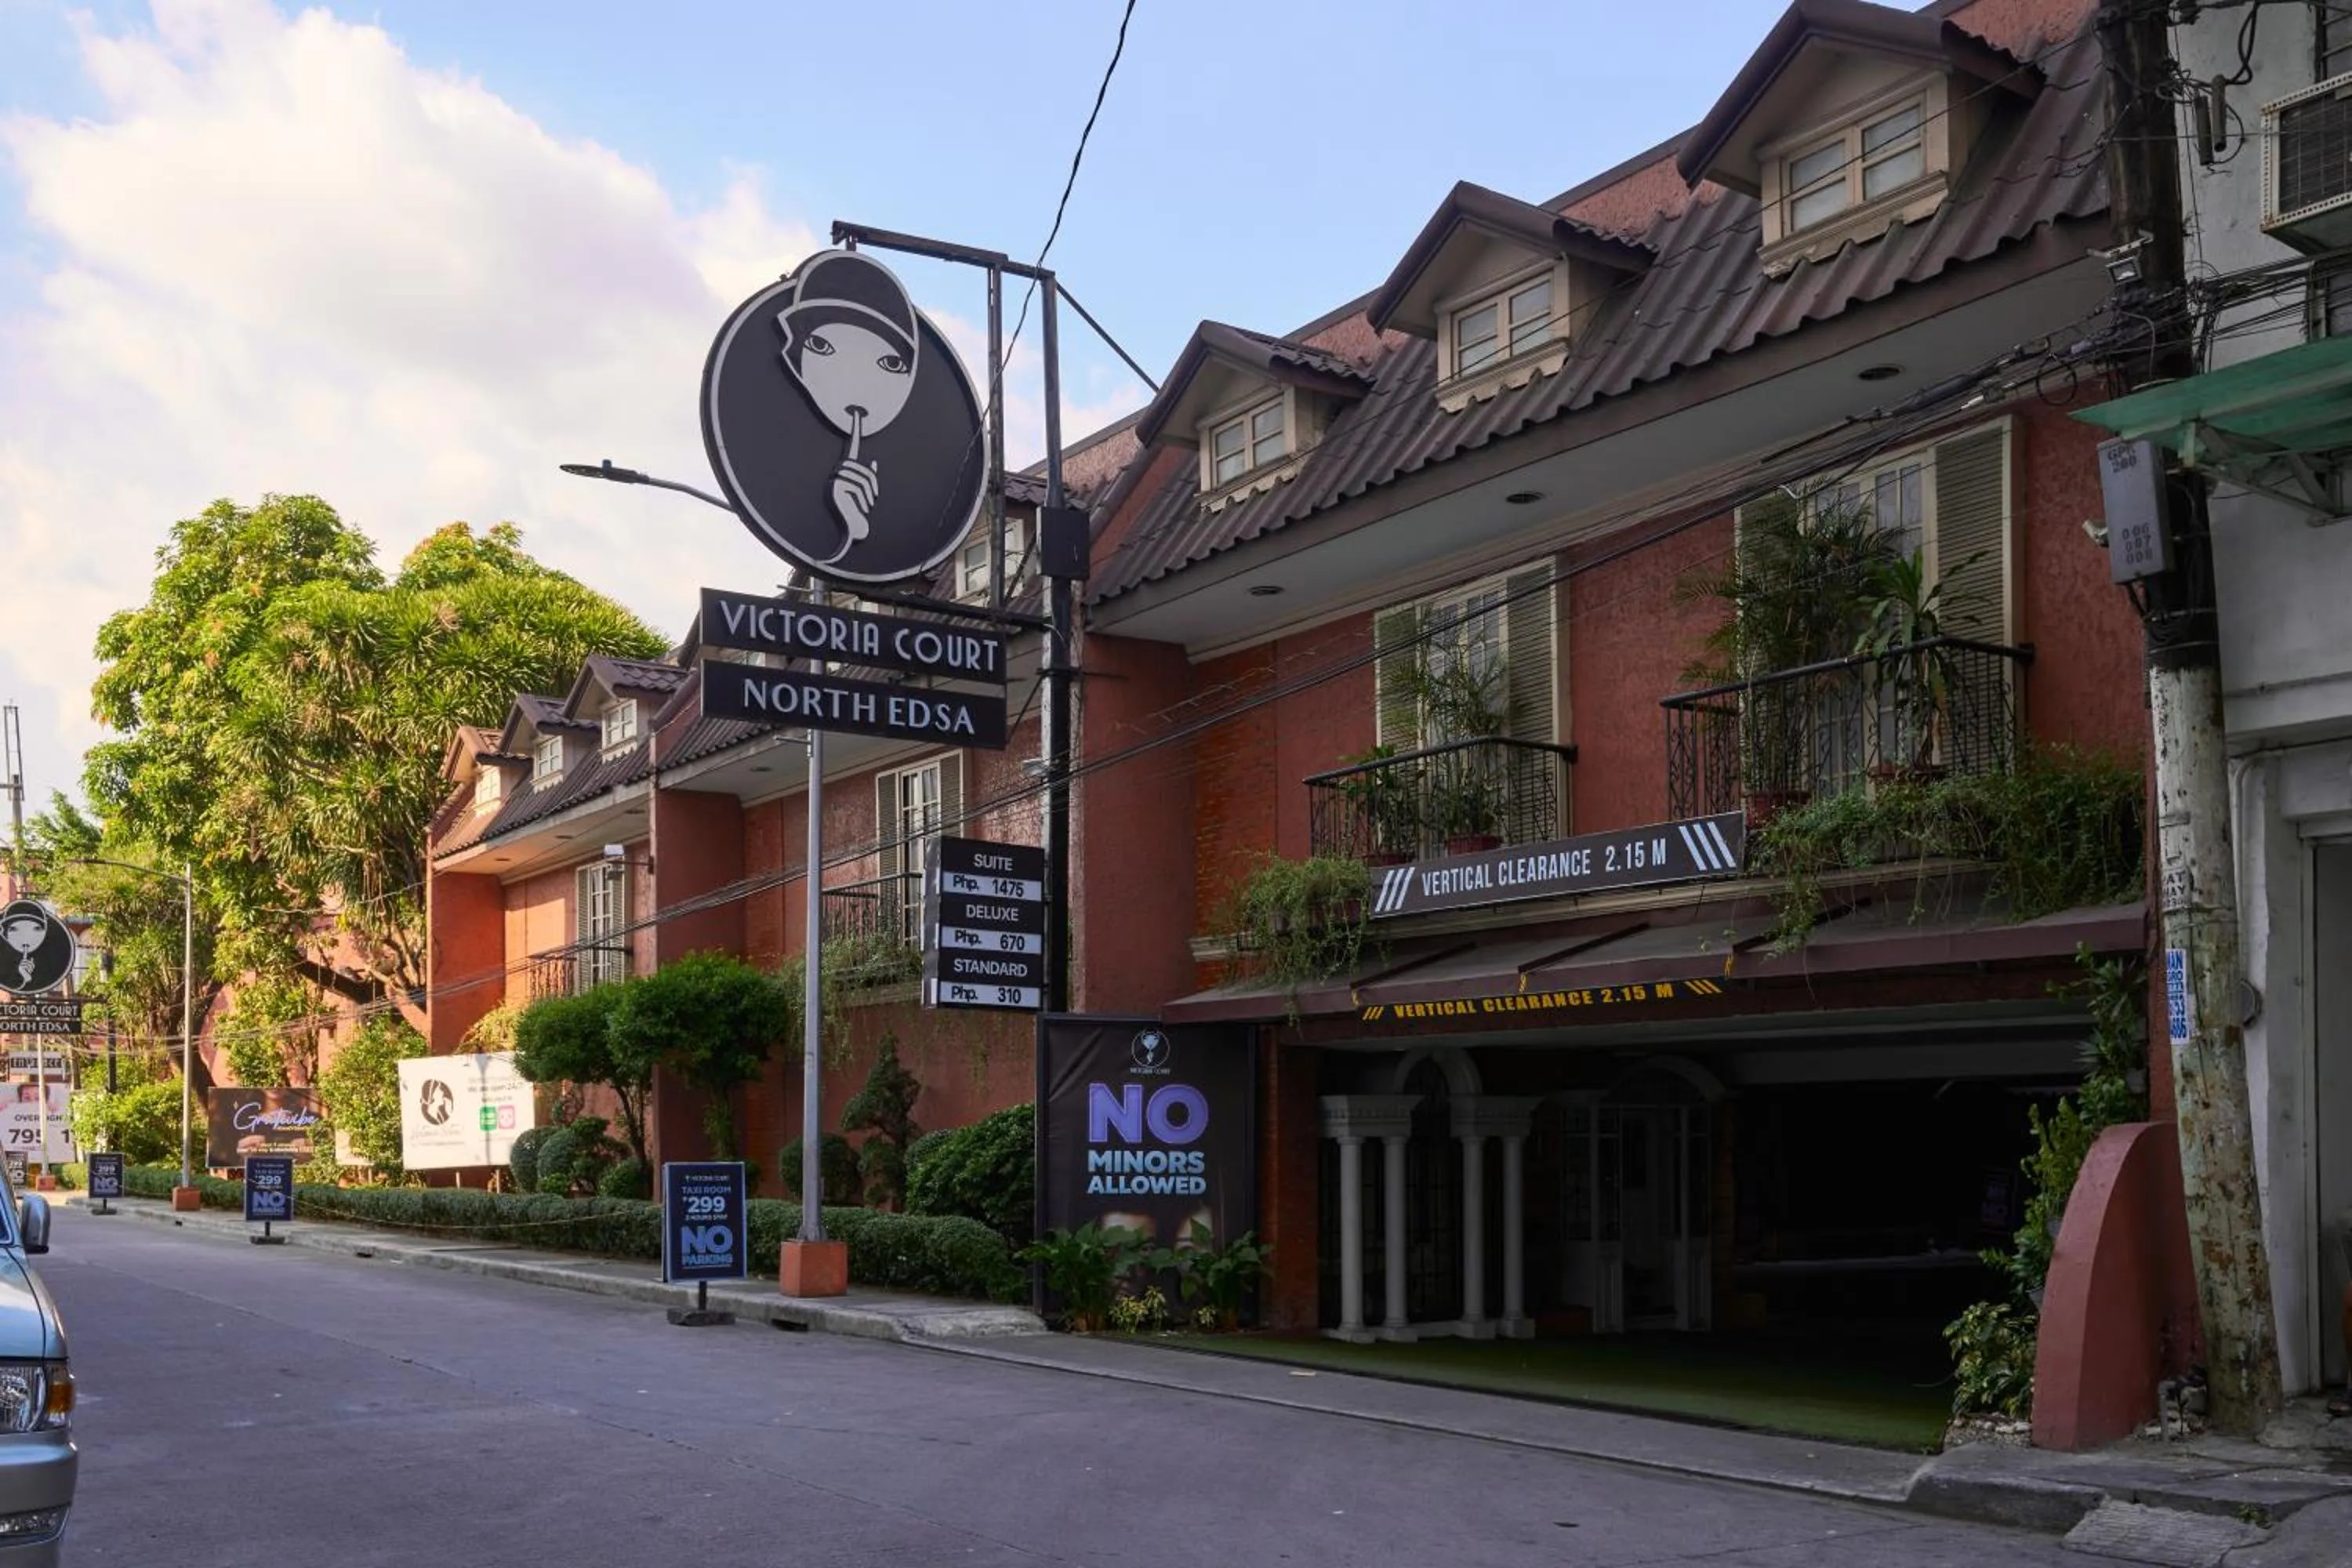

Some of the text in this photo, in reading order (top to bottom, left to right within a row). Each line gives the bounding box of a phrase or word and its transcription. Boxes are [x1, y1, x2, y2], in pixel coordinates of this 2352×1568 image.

[720, 600, 999, 672] VICTORIA COURT
[743, 678, 975, 735] NORTH EDSA
[974, 854, 1014, 871] SUITE
[1421, 838, 1667, 897] VERTICAL CLEARANCE 2.15 M
[953, 875, 1024, 898] Php. 1475
[965, 904, 1019, 921] DELUXE
[954, 929, 1025, 951] Php. 670
[953, 958, 1028, 977] STANDARD
[951, 985, 1022, 1004] Php. 310
[1392, 984, 1675, 1018] VERTICAL CLEARANCE 2.15 M
[42, 1005, 78, 1017] COURT
[39, 1022, 70, 1031] EDSA
[1089, 1083, 1209, 1145] NO
[1087, 1149, 1205, 1174] MINORS
[1087, 1175, 1207, 1195] ALLOWED
[253, 1192, 286, 1207] NO
[681, 1225, 733, 1254] NO
